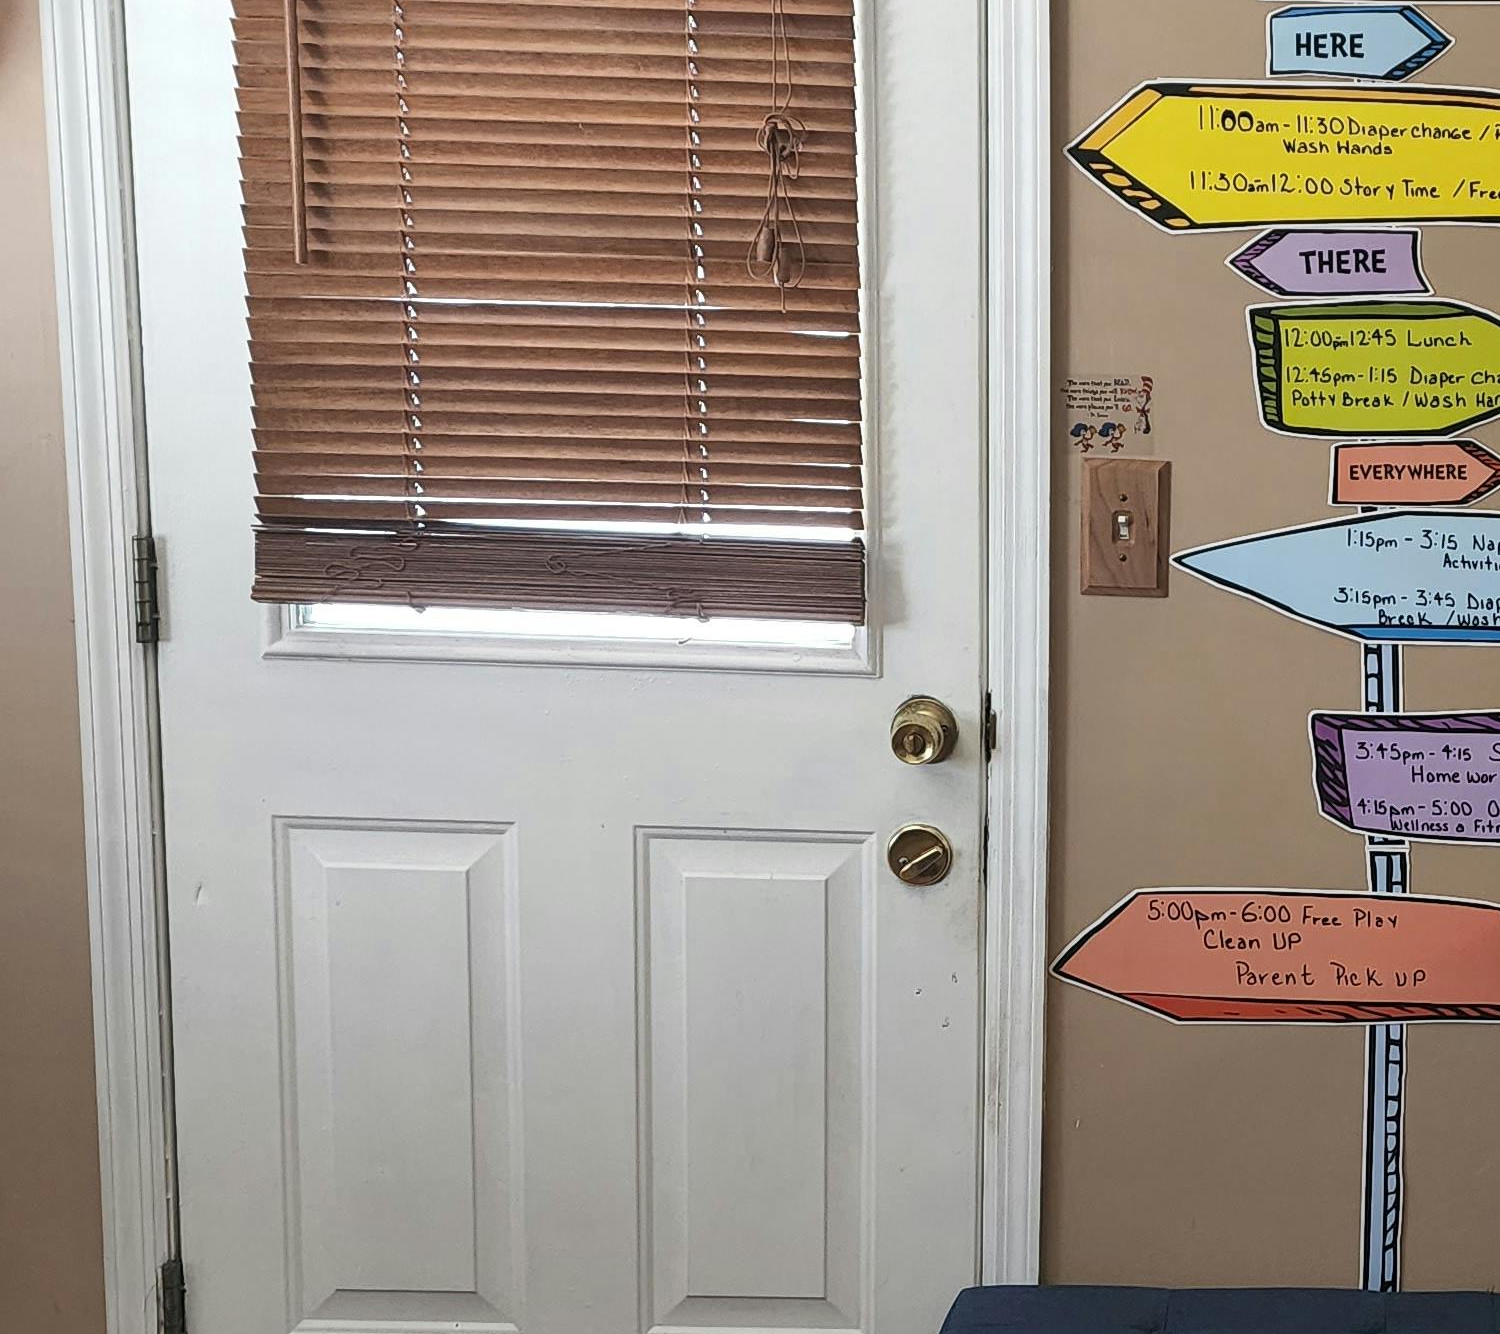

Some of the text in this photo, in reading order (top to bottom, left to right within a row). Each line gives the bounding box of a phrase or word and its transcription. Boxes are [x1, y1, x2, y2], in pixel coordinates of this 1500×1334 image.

[1295, 32, 1364, 59] HERE
[1346, 116, 1407, 140] Diaper
[1283, 138, 1393, 155] Wash Hands
[1402, 178, 1440, 198] Time
[1299, 249, 1386, 275] THERE
[1407, 329, 1472, 347] Lunch
[1410, 365, 1465, 388] Diaper
[1292, 389, 1336, 407] Potty
[1342, 391, 1394, 407] Break
[1414, 391, 1466, 408] Wash
[1349, 463, 1468, 482] EVERYWHERE
[1420, 529, 1458, 550] 3:15
[1415, 589, 1456, 608] 3:45
[1442, 743, 1472, 762] 4:15
[1432, 799, 1473, 817] 5:00
[1391, 818, 1449, 832] Wellness
[1302, 906, 1342, 927] Free
[1353, 908, 1398, 928] Play
[1203, 929, 1260, 950] Clean
[1235, 961, 1315, 986] Parent
